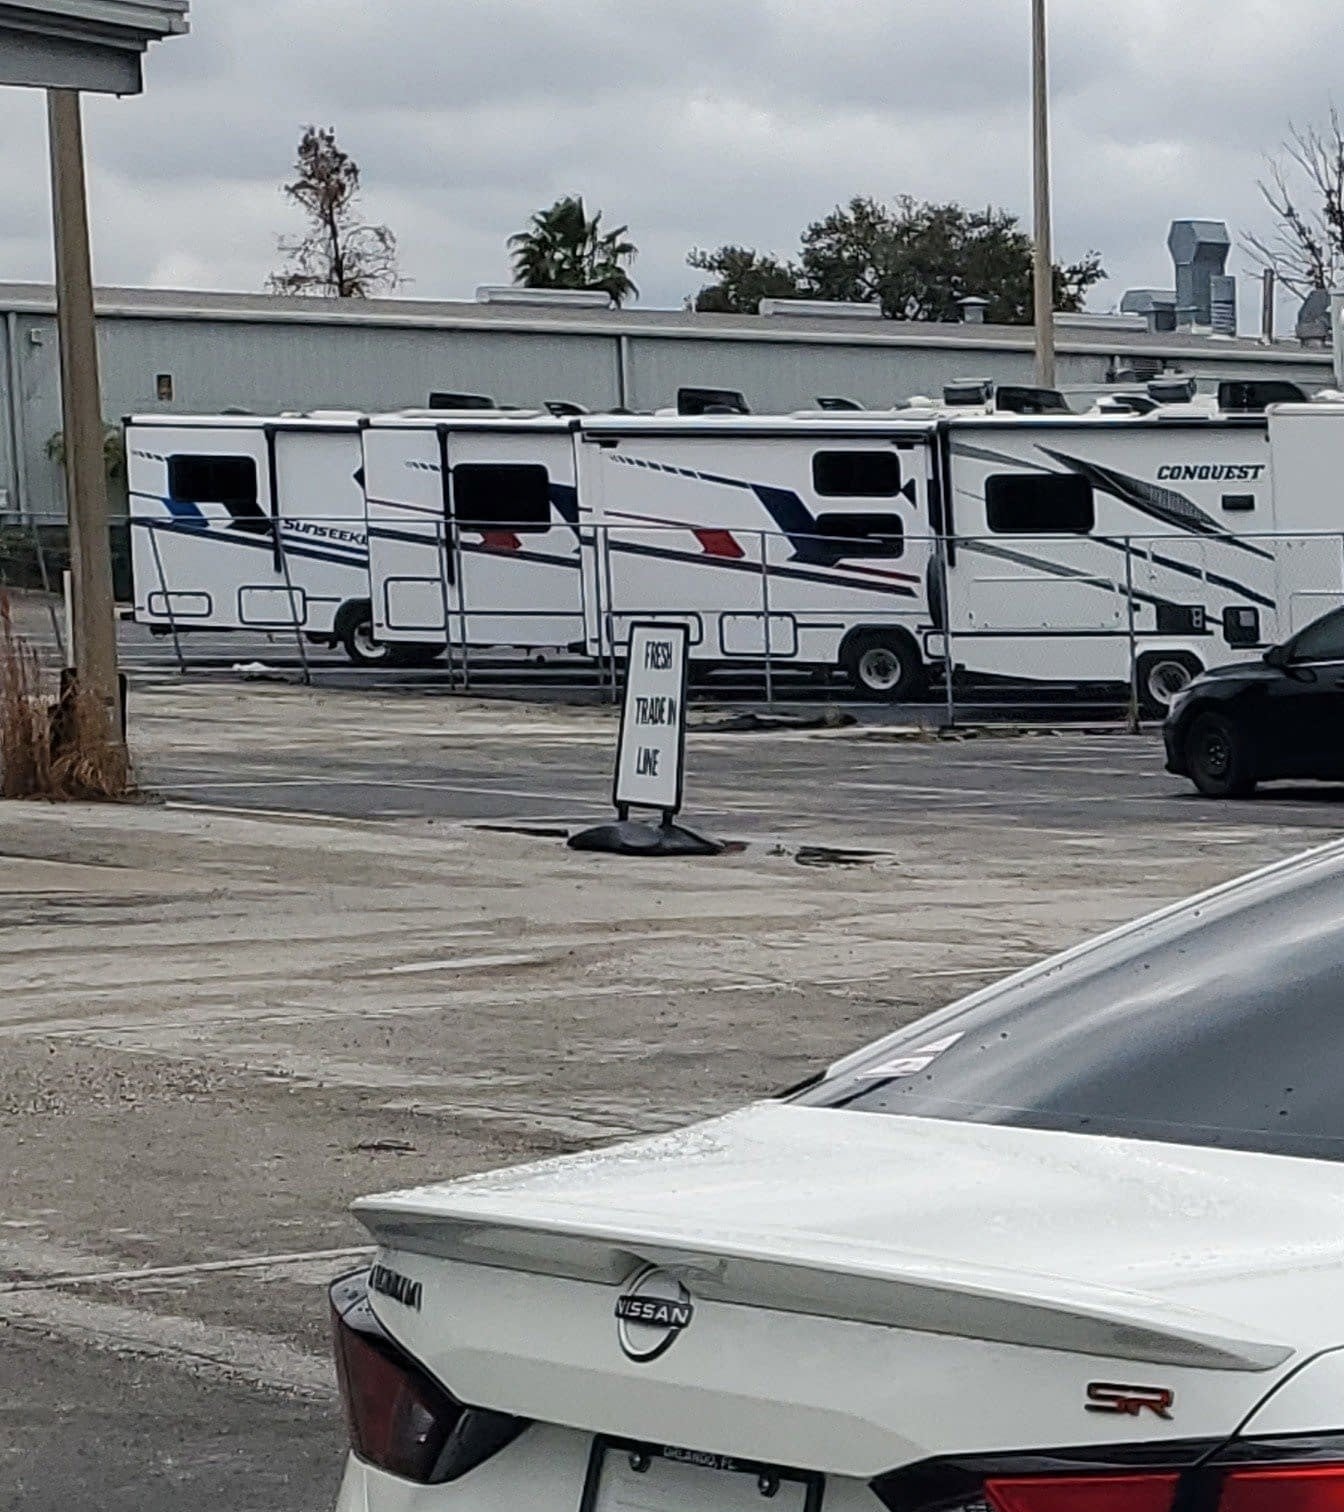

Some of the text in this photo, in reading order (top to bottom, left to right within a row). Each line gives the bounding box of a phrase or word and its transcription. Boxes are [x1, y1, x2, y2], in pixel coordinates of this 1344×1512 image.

[1157, 464, 1266, 480] CONQUEST
[645, 641, 672, 670] FRESH
[636, 697, 677, 726] TRADE IN
[636, 747, 660, 776] LINE
[618, 1299, 689, 1324] NISSAN
[1084, 1382, 1175, 1420] SR
